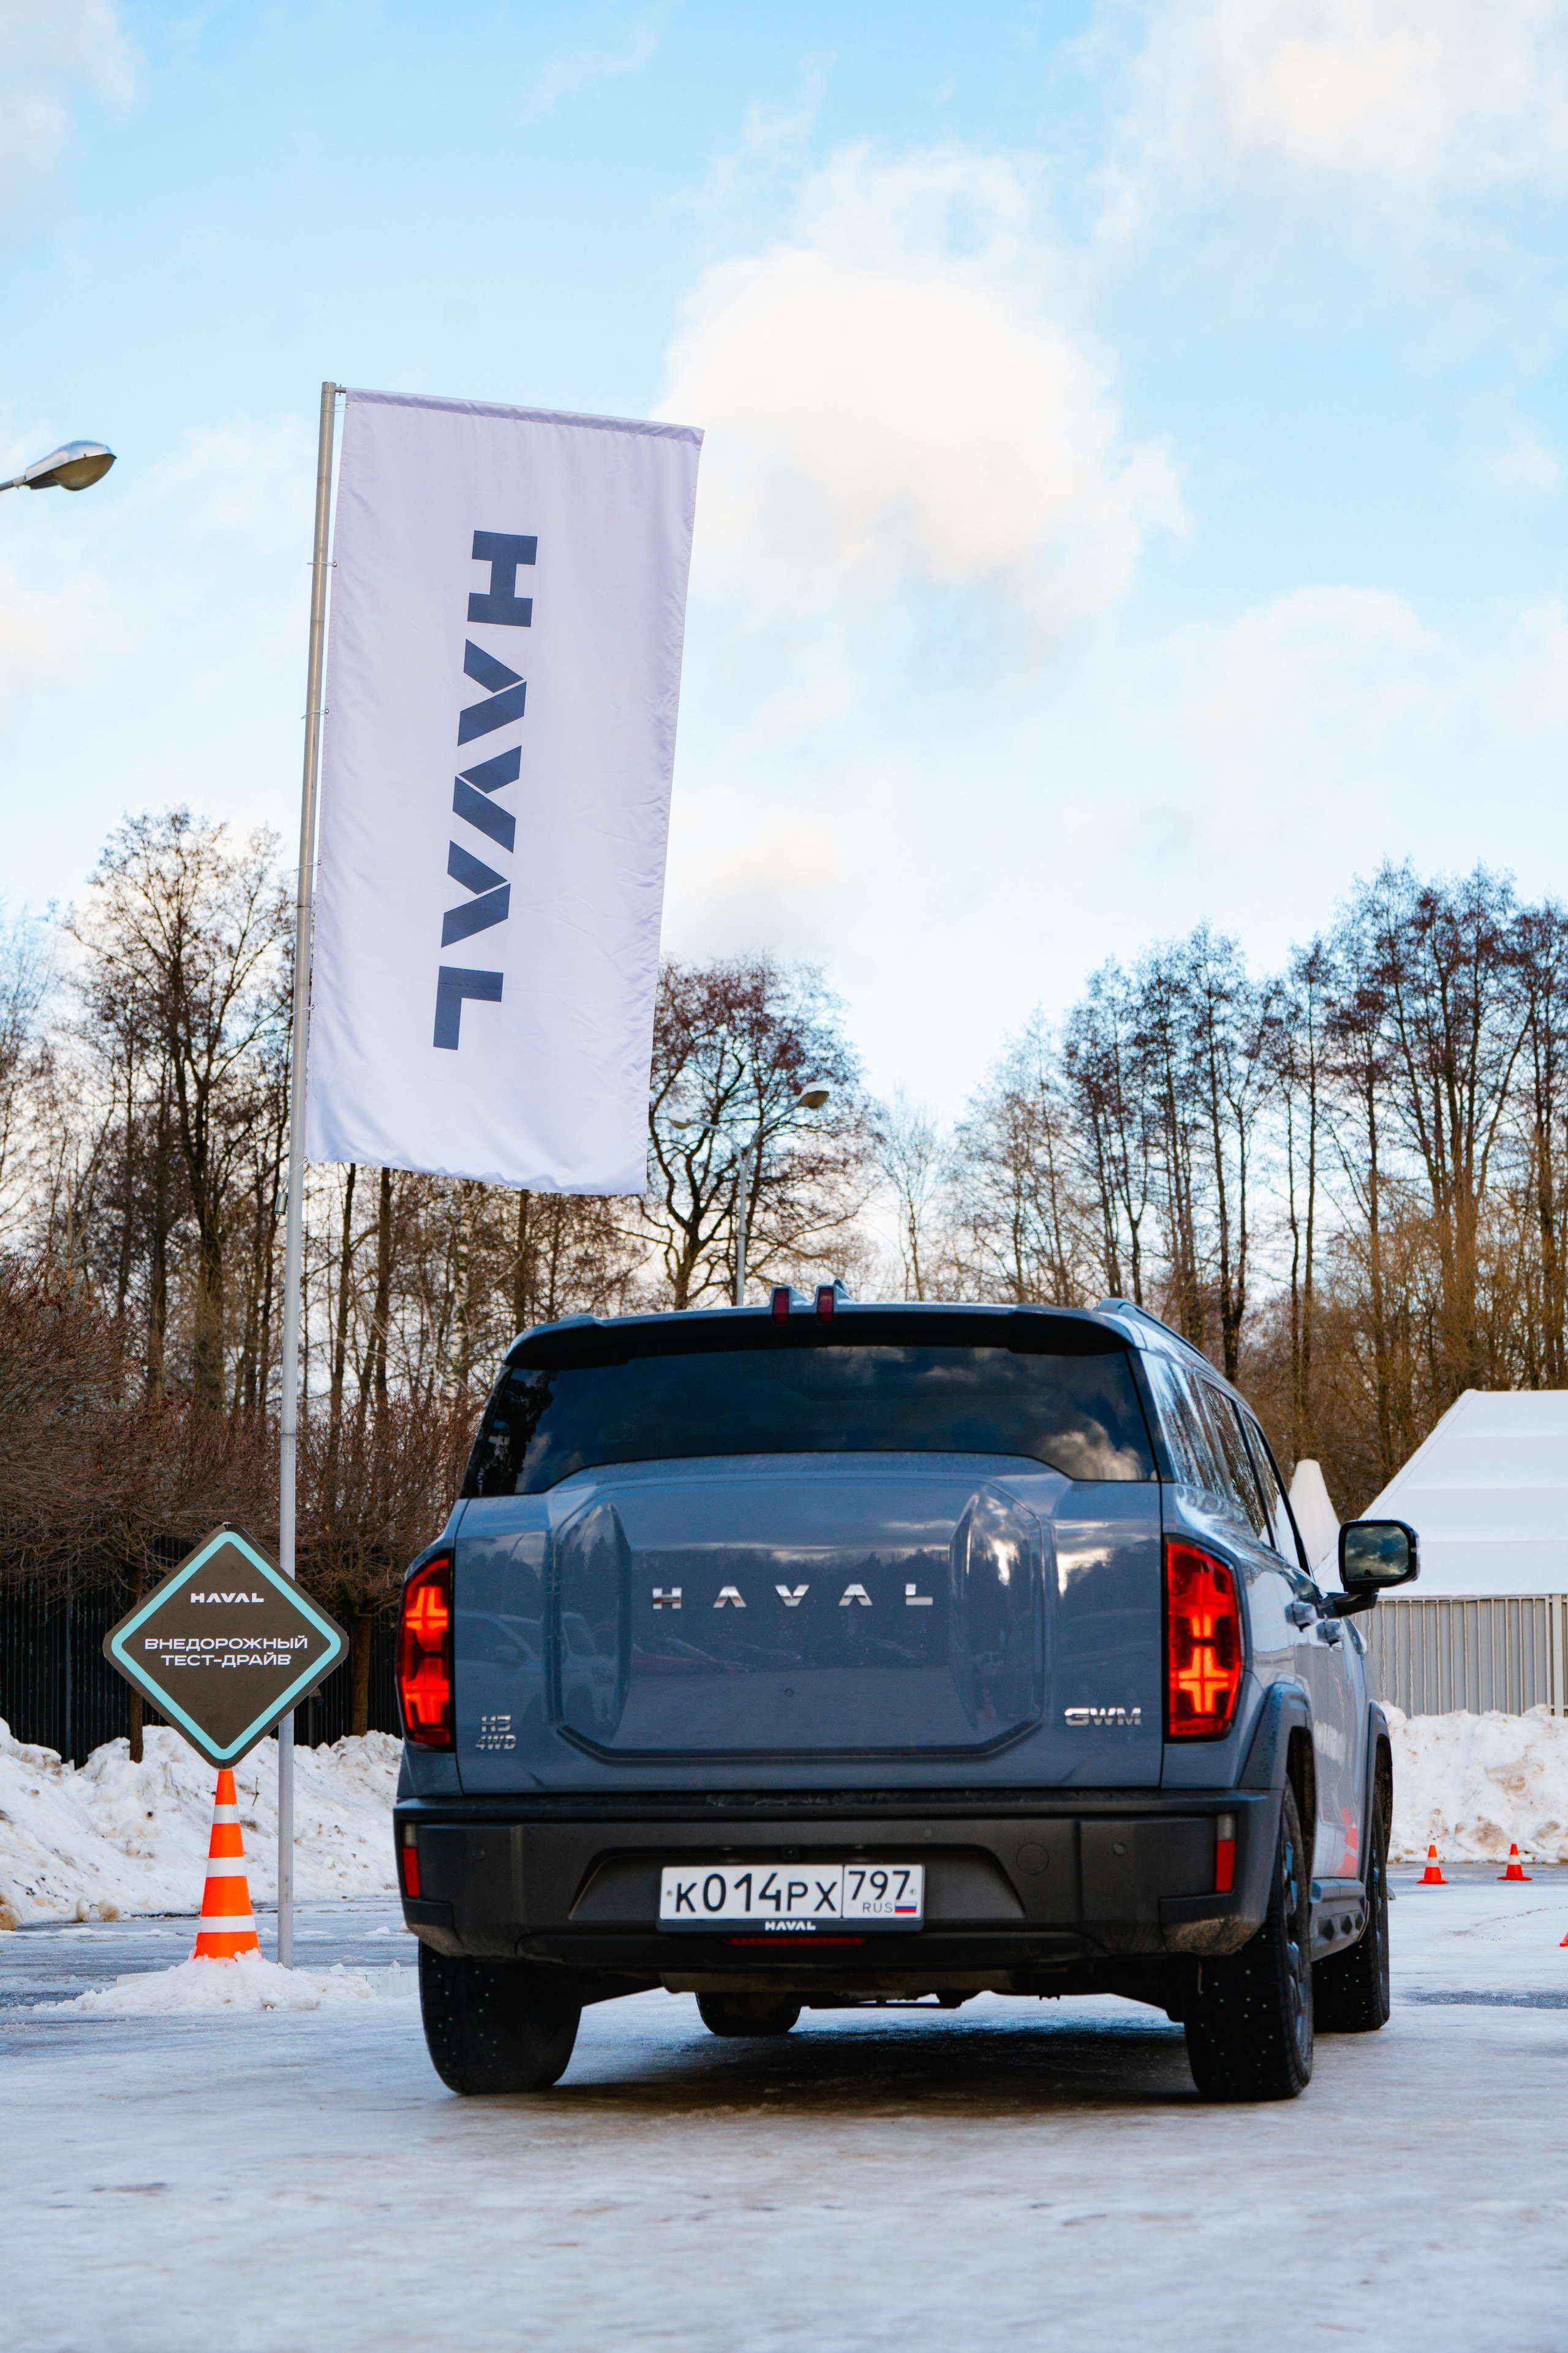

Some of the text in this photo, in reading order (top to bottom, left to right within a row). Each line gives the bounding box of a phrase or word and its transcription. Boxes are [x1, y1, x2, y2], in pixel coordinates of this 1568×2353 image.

[433, 530, 538, 1051] HAVAL
[190, 1592, 265, 1603] HAVAL
[652, 1583, 933, 1610] HAVAL
[145, 1635, 308, 1652] ВНЕДОРОЖНЫЙ
[160, 1652, 292, 1668] ТЕСТ-ДРАЙВ
[481, 1715, 511, 1732] H3
[1064, 1707, 1142, 1726] GWM
[475, 1734, 516, 1750] 4WD
[862, 1902, 893, 1914] RUS
[764, 1921, 816, 1931] HAVAL
